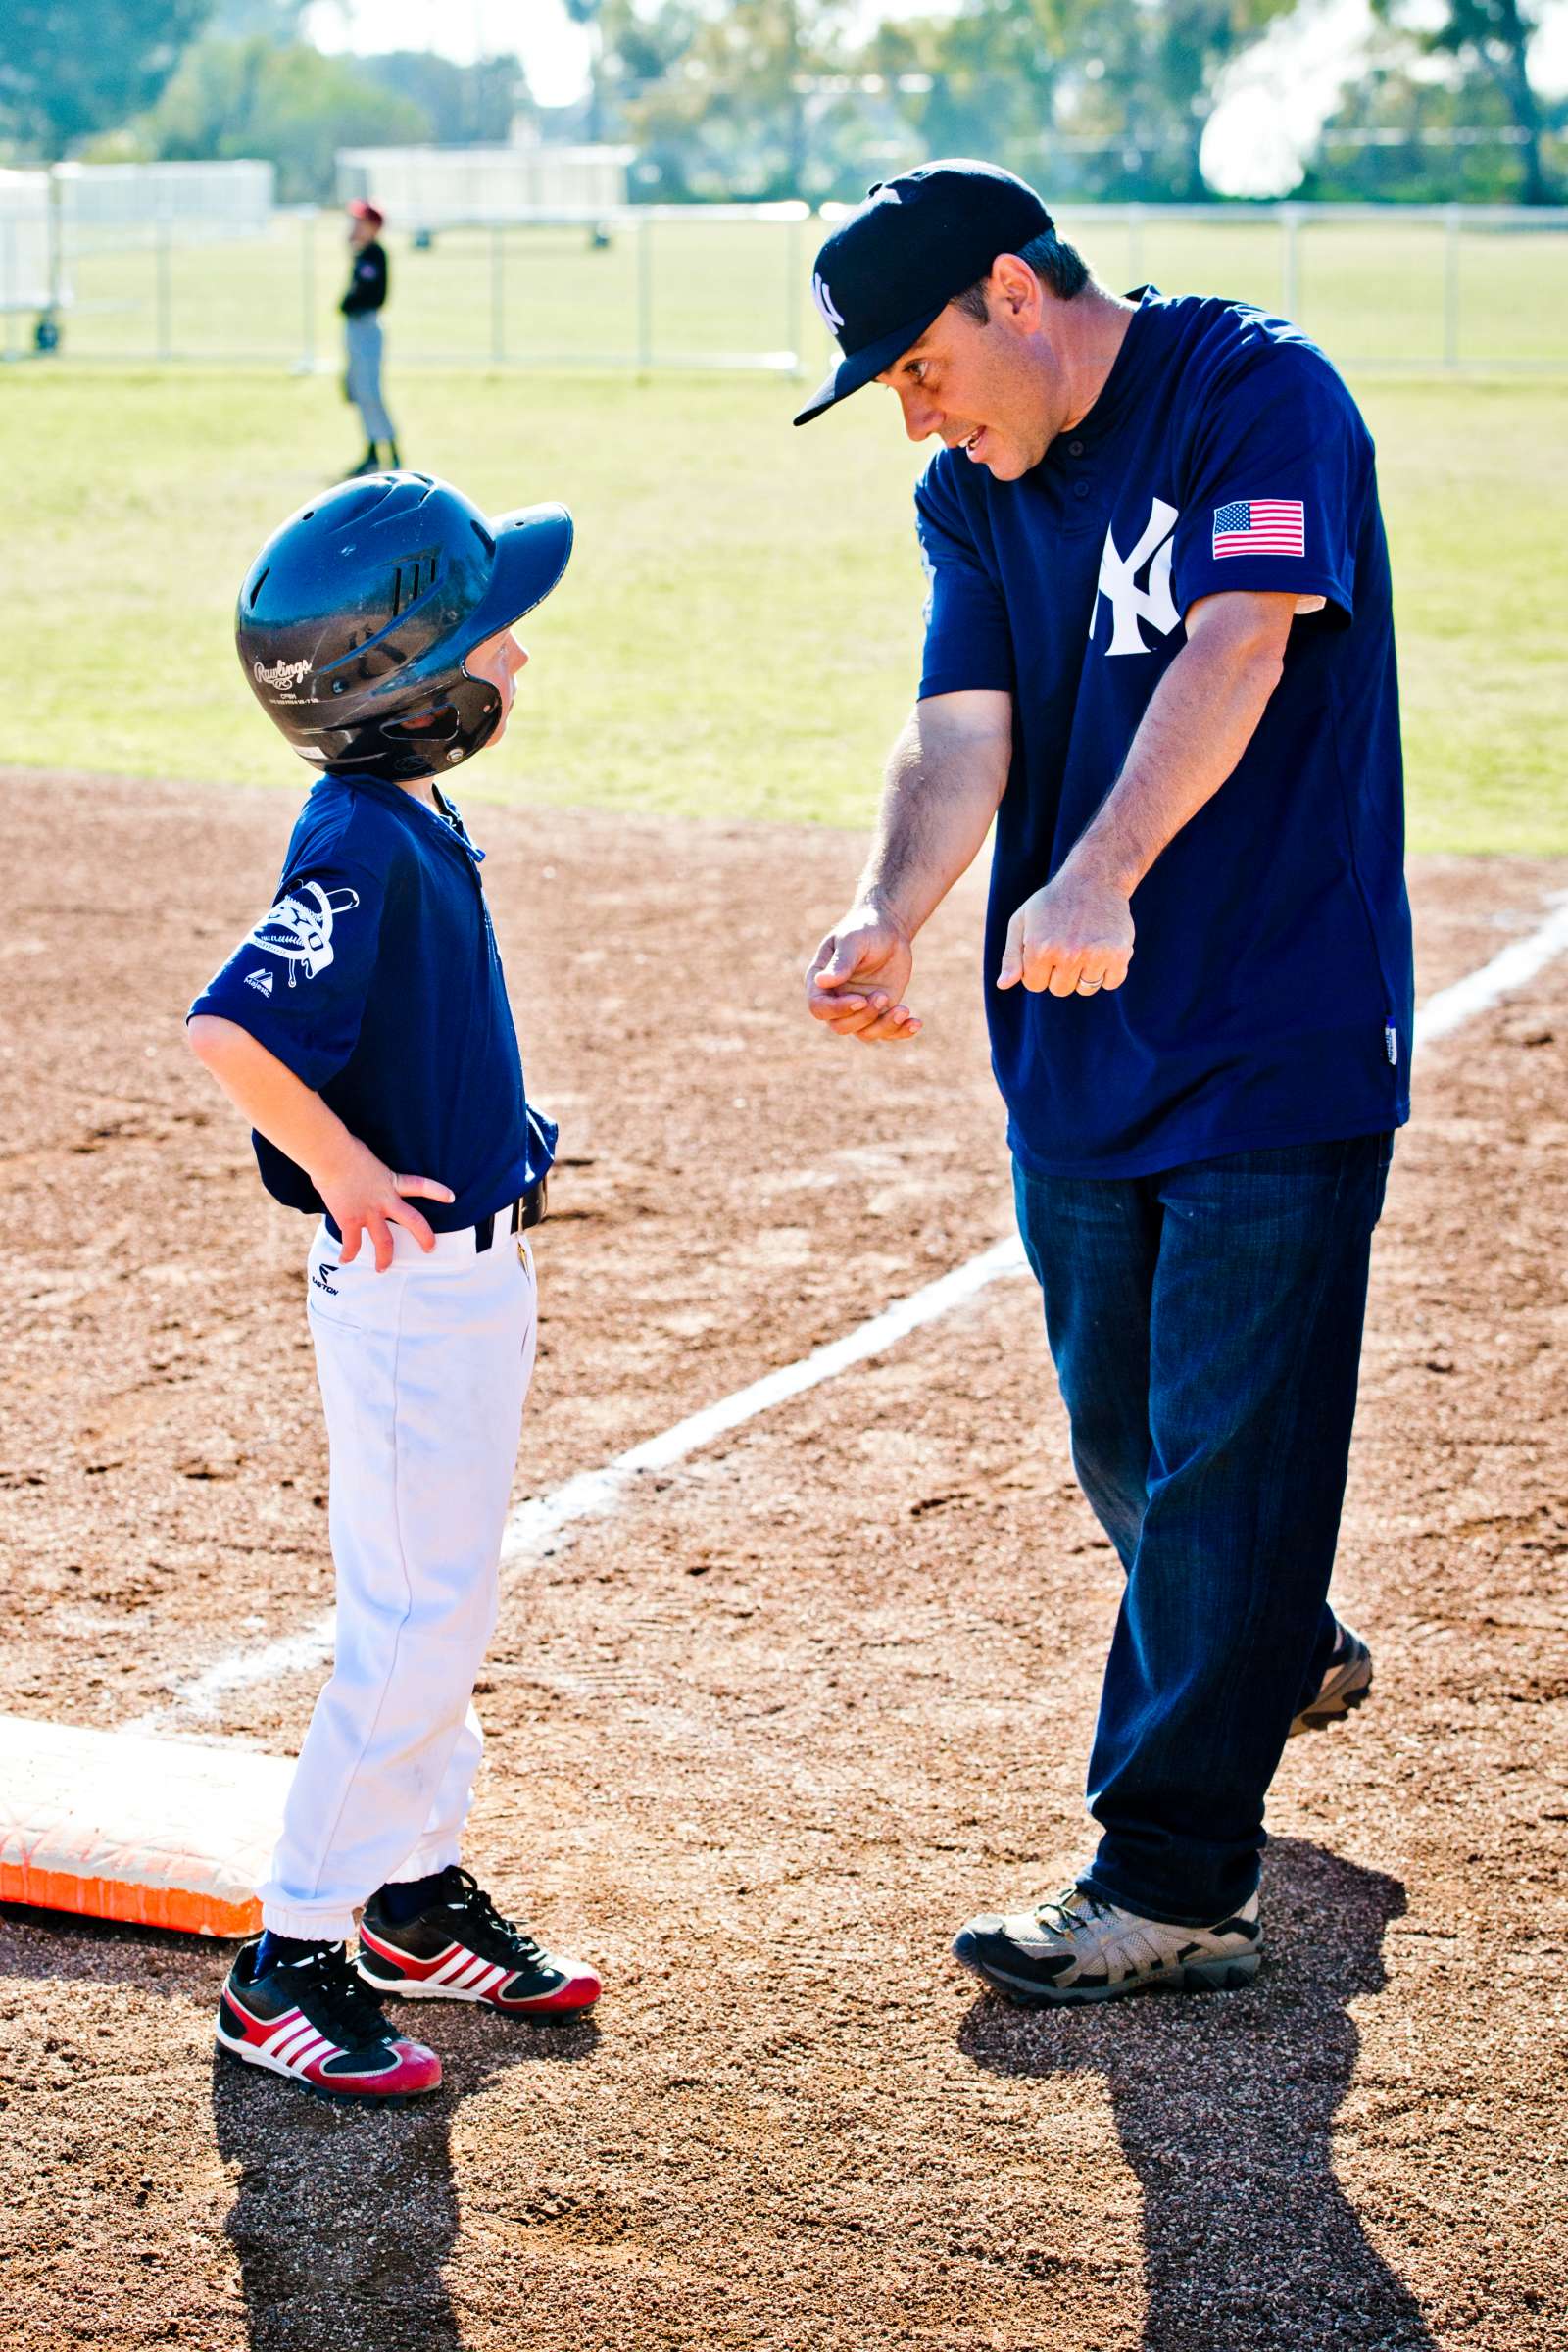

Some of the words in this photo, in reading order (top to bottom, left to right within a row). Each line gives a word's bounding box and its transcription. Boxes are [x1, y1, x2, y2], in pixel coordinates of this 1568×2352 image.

[1088, 497, 1182, 656] NY
[253, 659, 313, 684] Rawlings
[243, 977, 270, 998] Majestic
